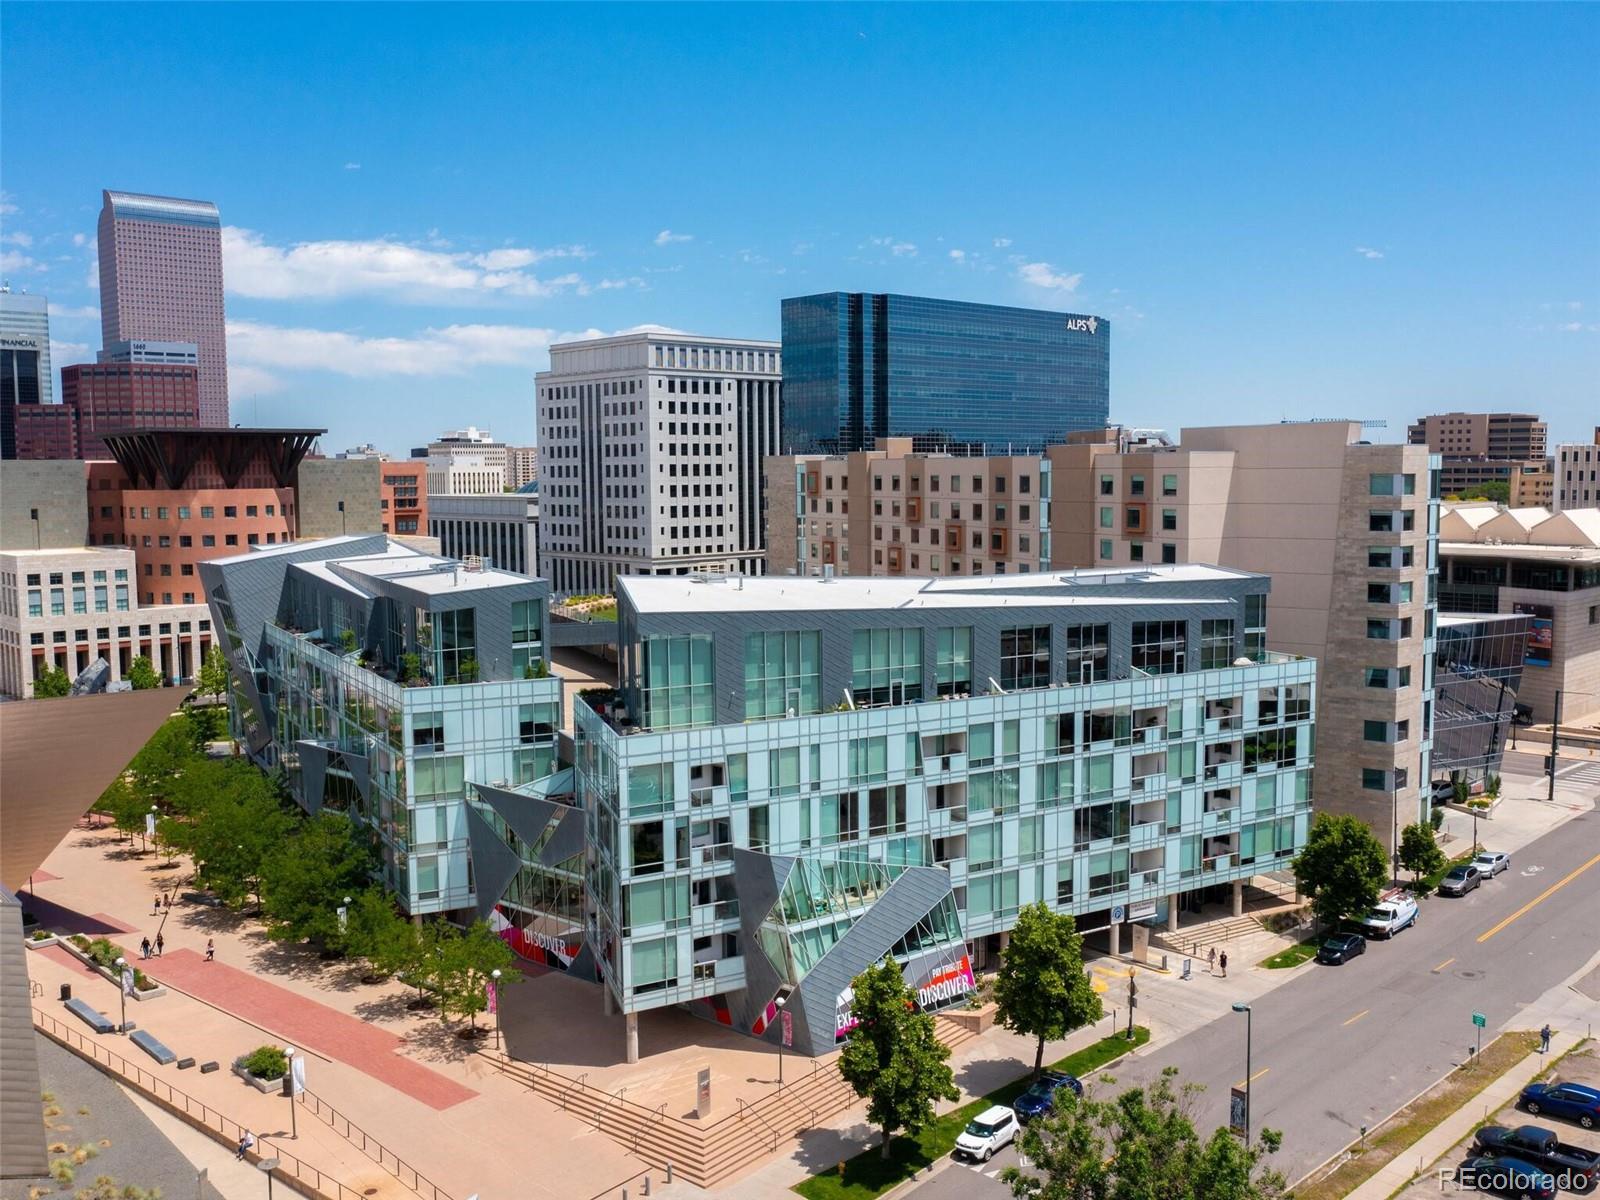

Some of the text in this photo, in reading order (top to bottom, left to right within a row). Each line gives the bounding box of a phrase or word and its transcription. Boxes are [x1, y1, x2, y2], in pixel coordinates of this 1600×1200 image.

[1067, 319, 1087, 330] ALPS
[523, 928, 566, 956] DISCOVER
[920, 975, 970, 1007] DISCOVER
